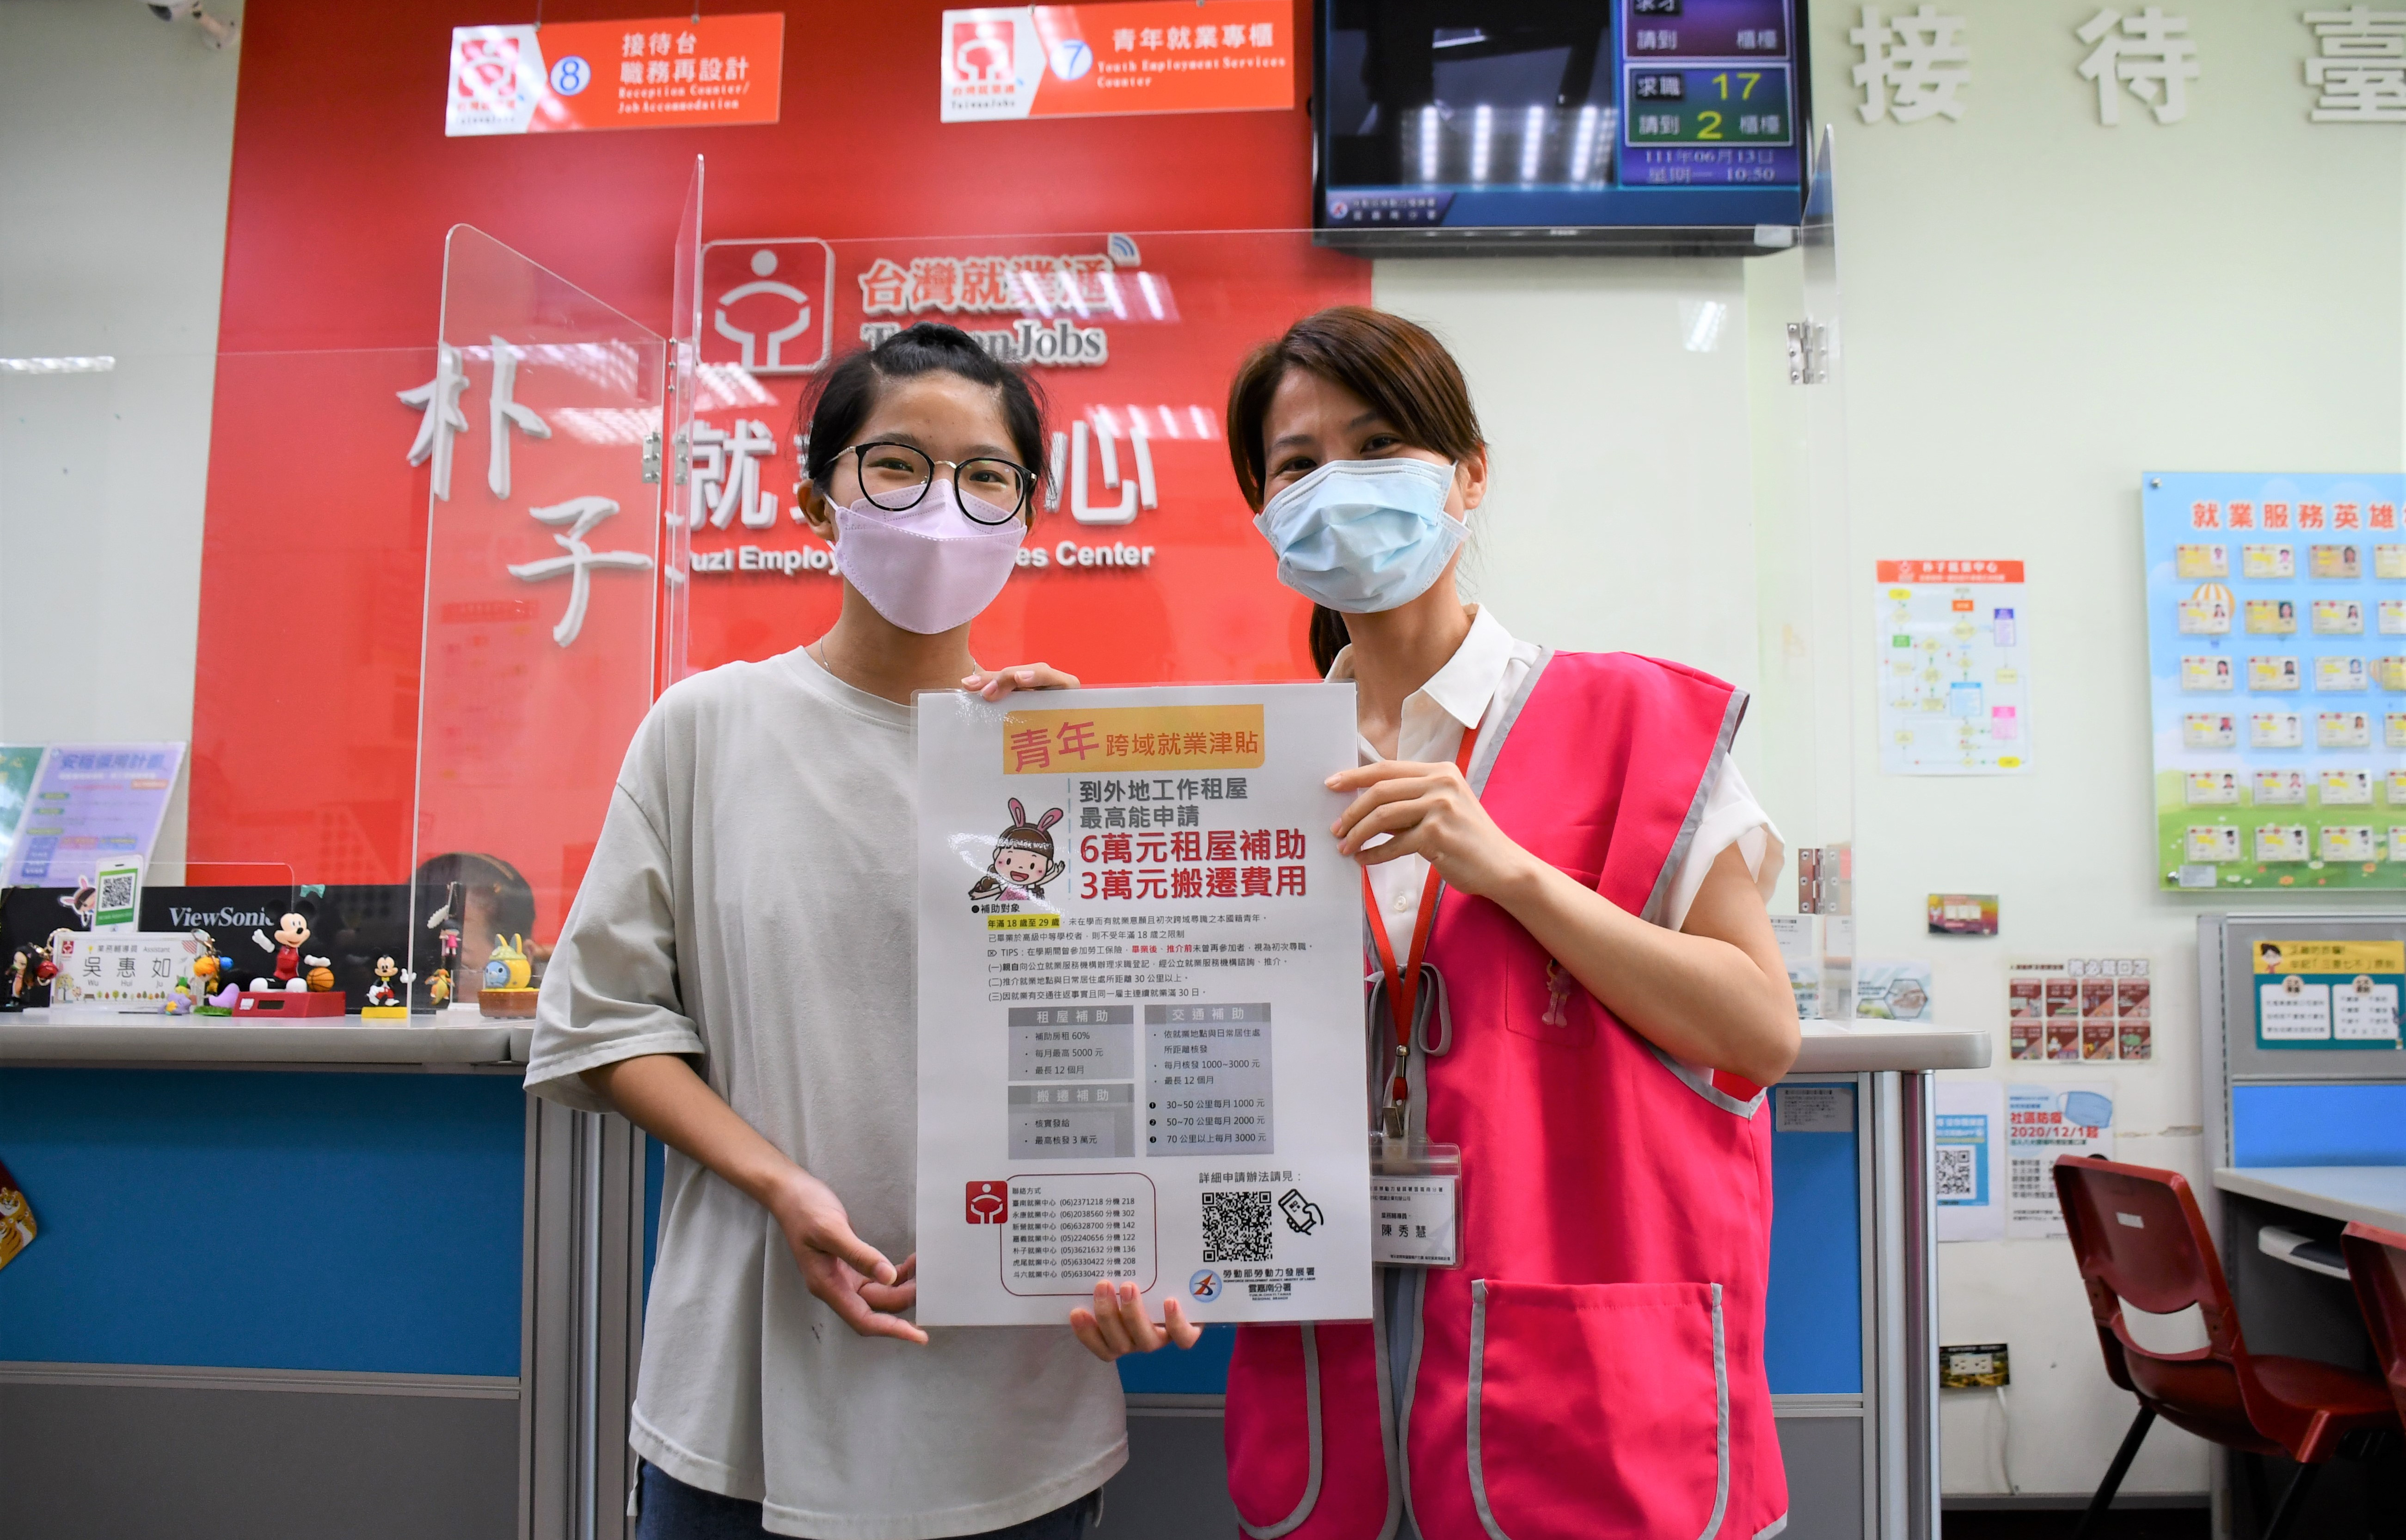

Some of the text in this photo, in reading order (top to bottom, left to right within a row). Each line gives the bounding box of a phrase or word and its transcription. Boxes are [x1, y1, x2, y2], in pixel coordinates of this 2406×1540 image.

[1113, 23, 1274, 52] 青年就業專櫃
[622, 31, 697, 57] 接待台
[1063, 44, 1084, 78] 7
[1098, 56, 1286, 74] Youth Employment Services
[559, 58, 580, 92] 8
[620, 56, 749, 84] 職務再設計
[1098, 75, 1152, 89] Counter
[1712, 72, 1762, 100] 17
[618, 84, 687, 100] Reception
[1696, 110, 1723, 140] 2
[858, 253, 1114, 315] 台灣就業通
[859, 318, 1109, 366] TnJobs
[2191, 502, 2406, 531] 就業服務英雄
[1055, 540, 1156, 568] Center
[1010, 720, 1258, 774] 青年 跨域就業津貼
[1079, 777, 1248, 804] 到外地工作租屋
[1079, 805, 1200, 830] 最高能申請
[1080, 828, 1307, 864] 6萬元租屋補助
[1080, 865, 1307, 901] 3萬元搬遷費用
[981, 903, 1020, 914] 補助對象
[988, 919, 1005, 928] 年滿
[1150, 929, 1185, 939] 歲之限制
[143, 945, 171, 953] Assistant
[83, 956, 172, 979] 吳惠如
[156, 980, 163, 988] Ju
[1135, 975, 1145, 983] 30
[1178, 988, 1189, 997] 30
[1036, 1009, 1108, 1024] 租屋補助
[1172, 1006, 1244, 1021] 交通補助
[1035, 1031, 1090, 1041] 補助房租 60%
[1164, 1028, 1261, 1039] 依就業地點與日常居住處
[1035, 1048, 1104, 1058] 每月最高 5000 元
[1164, 1045, 1208, 1055] 所距離核發
[1035, 1066, 1052, 1075] 最長
[1068, 1065, 1084, 1075] 個月
[1164, 1059, 1260, 1070] 每月核發 1000~3000 元
[1164, 1075, 1214, 1085] 最長 12 個月
[1037, 1088, 1109, 1103] 搬遷補助
[1166, 1098, 1265, 1109] 30~50 公里每月 1000 元
[1035, 1118, 1070, 1129] 核實發給
[1166, 1116, 1265, 1126] 50~70 公里每月 2000 元
[1035, 1135, 1098, 1145] 最高核發 3 萬元
[1166, 1133, 1267, 1143] 70 公里以上每月 3000 元
[1060, 1198, 1105, 1207] (06)2371218
[1060, 1210, 1105, 1219] (06)2038560
[1060, 1222, 1105, 1230] (06)6328700
[1381, 1224, 1427, 1238] 陳秀慧
[1060, 1234, 1105, 1243] (05)2240656
[1060, 1246, 1105, 1255] (05)3621632
[1060, 1258, 1105, 1267] (05)6330422
[1060, 1270, 1105, 1279] (05)6330422
[1223, 1267, 1315, 1278] 勞動部勞動力發展署
